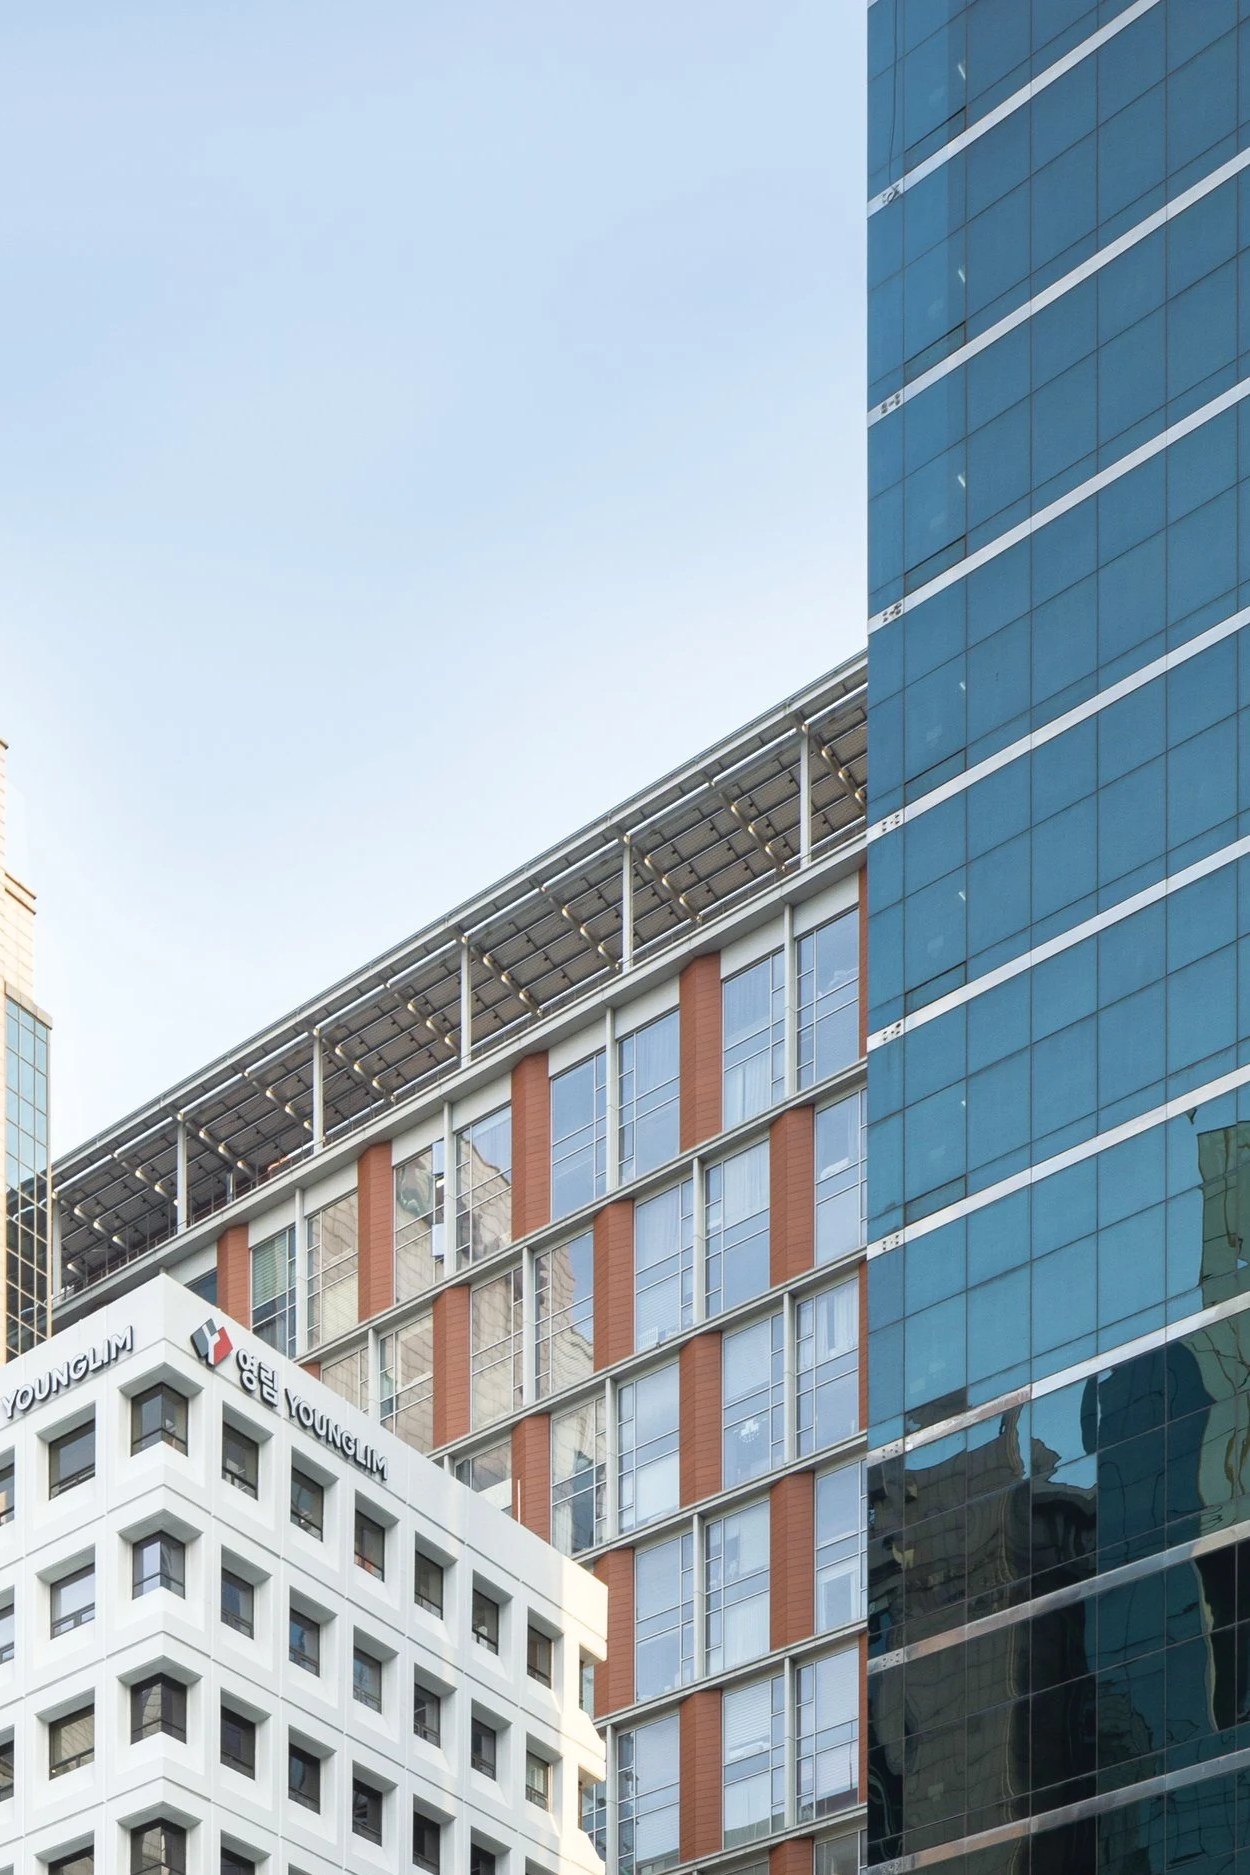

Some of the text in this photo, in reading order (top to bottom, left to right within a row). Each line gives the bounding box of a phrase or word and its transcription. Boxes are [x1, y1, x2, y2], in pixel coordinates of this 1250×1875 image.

[1, 1326, 133, 1419] YOUNGLIM
[237, 1349, 388, 1480] 영림 YOUNGLIM
